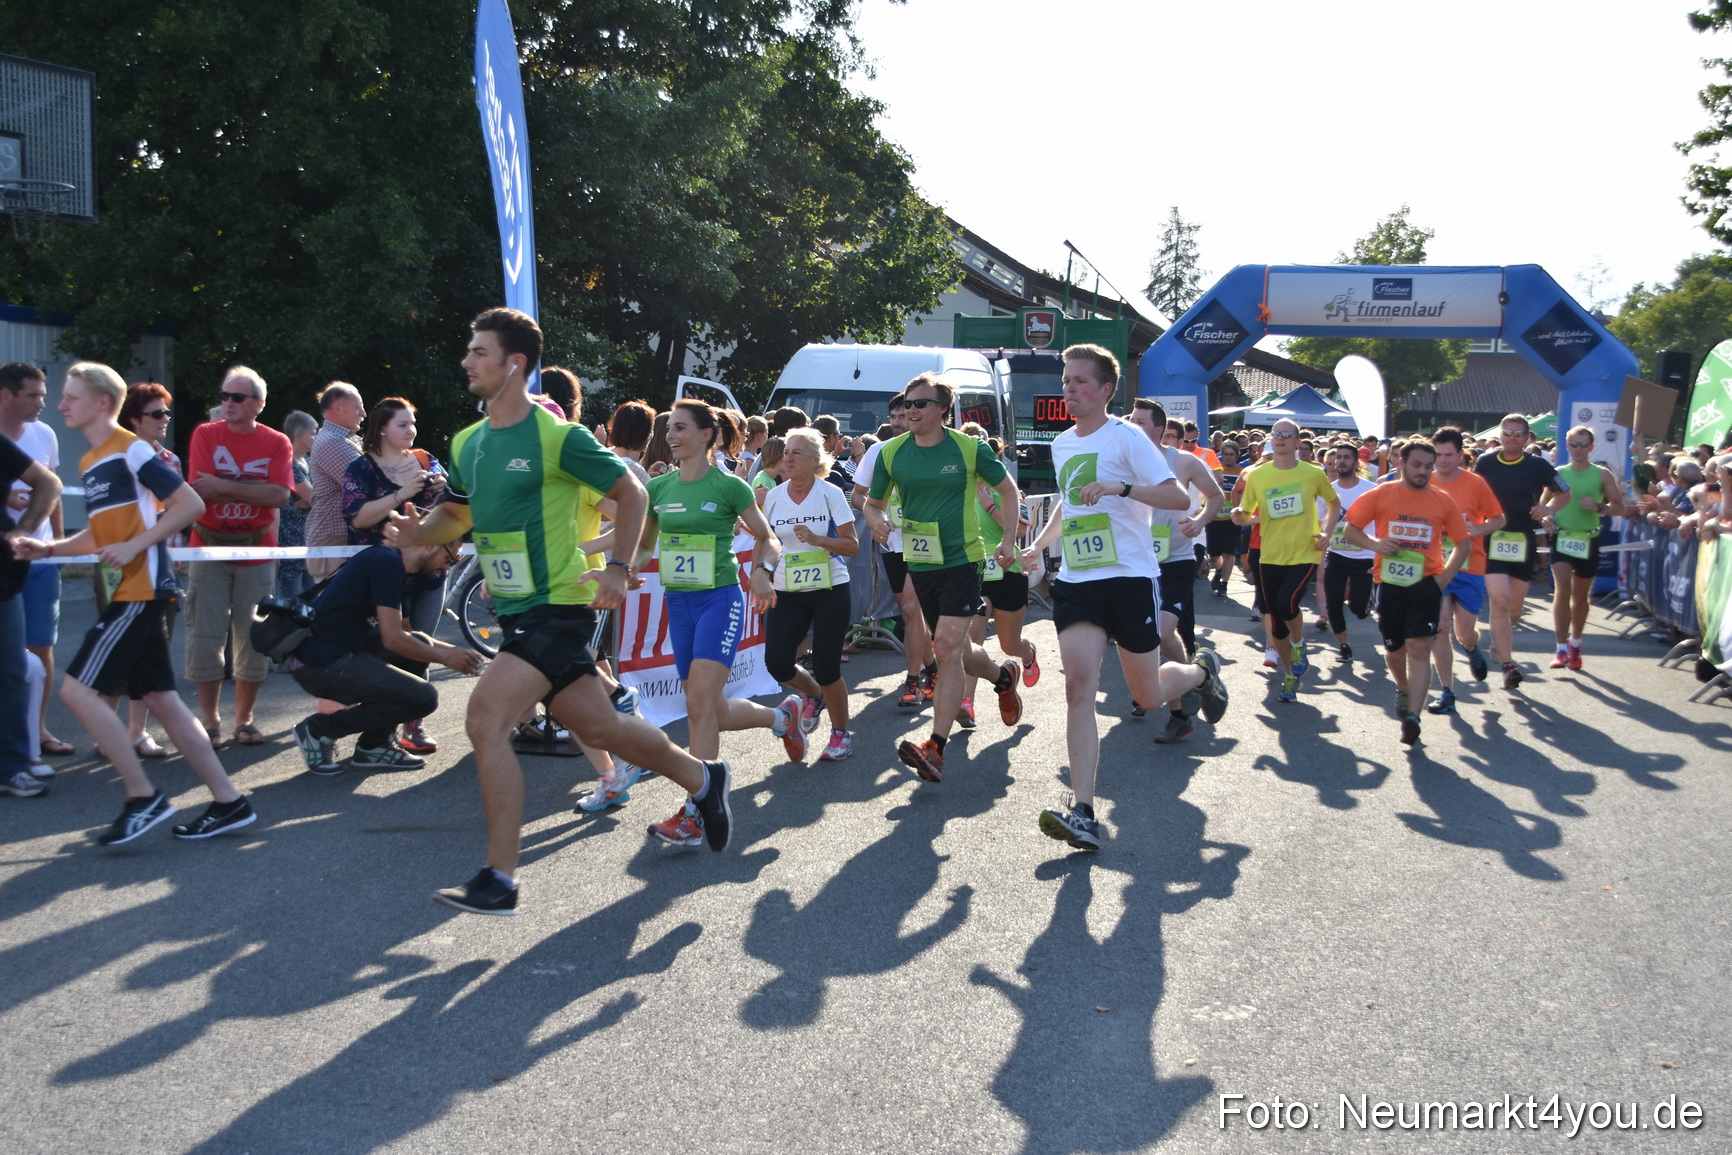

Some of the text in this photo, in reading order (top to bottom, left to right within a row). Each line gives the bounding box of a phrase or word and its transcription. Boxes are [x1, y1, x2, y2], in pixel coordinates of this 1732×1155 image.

[1381, 285, 1410, 293] Fischer
[1357, 301, 1446, 317] firmenlauf
[1193, 330, 1239, 339] Fischer
[1690, 399, 1725, 433] AOK
[506, 458, 531, 470] AOK
[941, 465, 958, 473] AOK
[1273, 497, 1296, 511] 657
[776, 515, 826, 526] DELPHI
[1391, 525, 1428, 538] OBI
[912, 538, 929, 552] 22
[1073, 535, 1104, 555] 119
[1497, 543, 1519, 553] 836
[1560, 540, 1586, 551] 1480
[492, 559, 513, 580] 19
[675, 556, 694, 573] 21
[1388, 562, 1414, 577] 624
[793, 568, 821, 583] 272
[721, 601, 742, 656] skinfit
